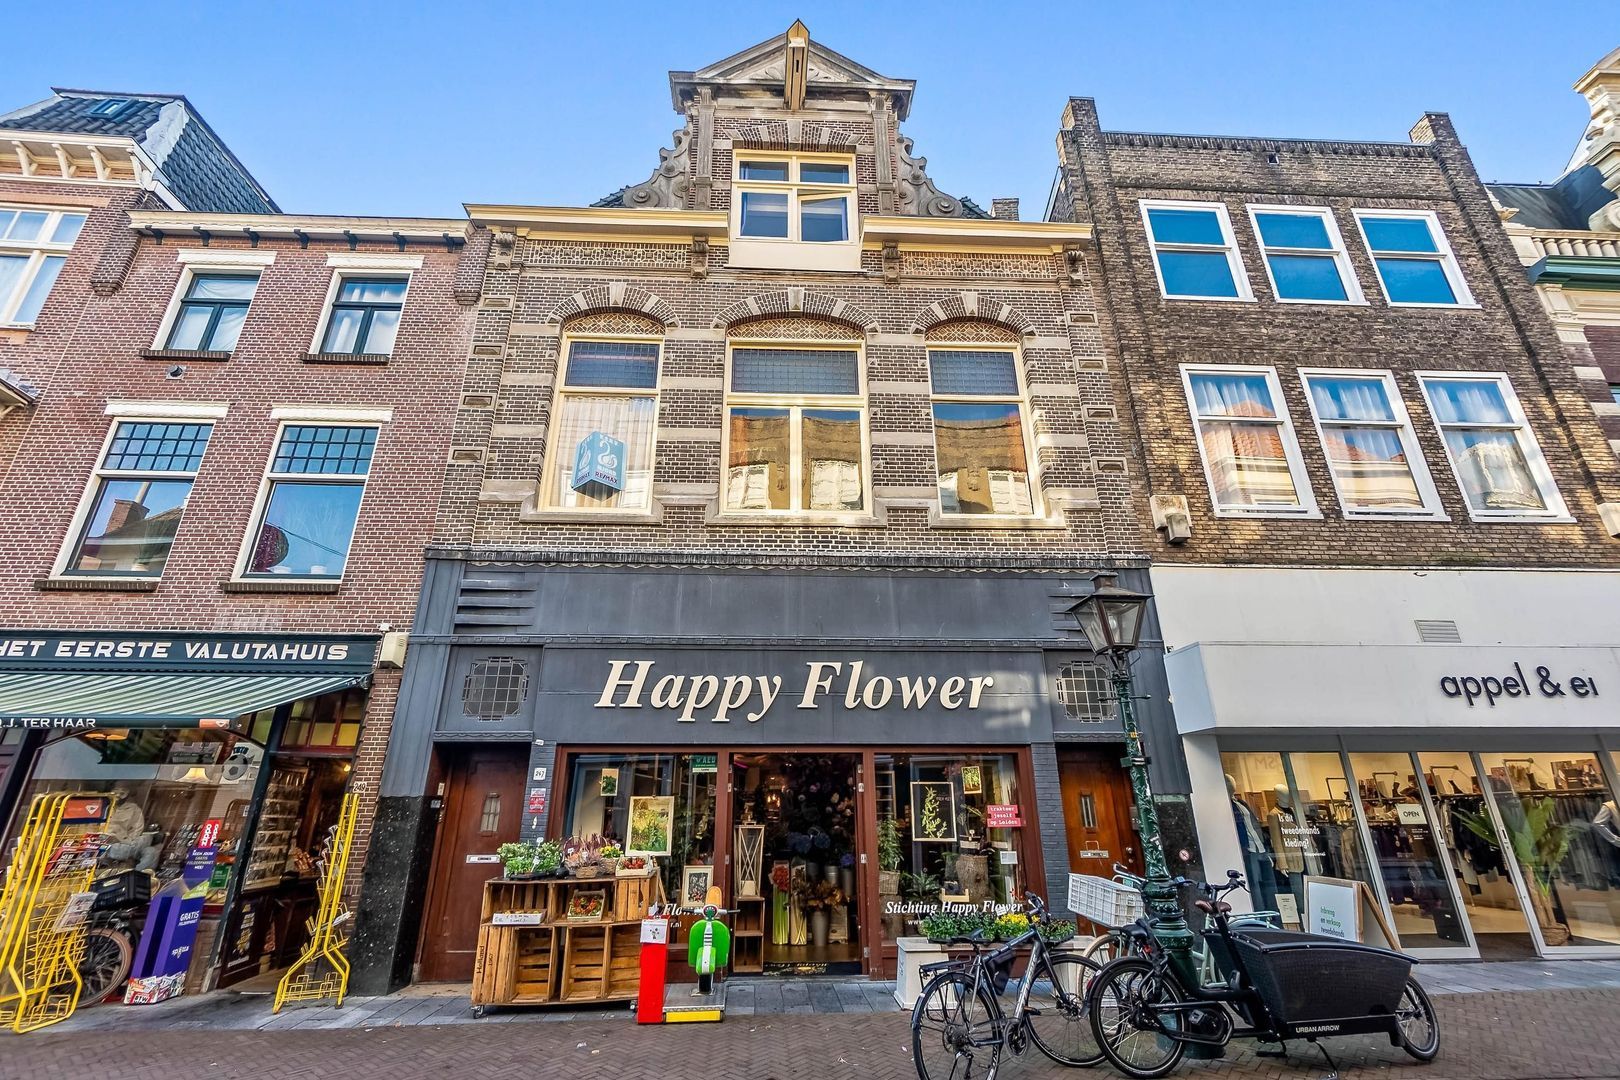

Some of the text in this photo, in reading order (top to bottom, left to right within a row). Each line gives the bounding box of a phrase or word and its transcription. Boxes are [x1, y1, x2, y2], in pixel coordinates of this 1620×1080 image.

[54, 641, 172, 658] EERSTE
[185, 642, 349, 660] VALUTAHUIS
[1440, 661, 1531, 706] appel
[1536, 665, 1567, 697] &
[594, 660, 994, 722] Happy Flower
[21, 718, 50, 728] TER
[54, 718, 96, 728] HAAR
[1281, 825, 1320, 835] tweedehands
[1284, 838, 1309, 849] kleding?
[885, 901, 937, 916] Stichting
[942, 900, 979, 916] Happy
[180, 911, 199, 922] GRATIS
[1327, 918, 1341, 928] verkoop
[1321, 927, 1345, 938] tweedehands
[476, 945, 484, 974] Holland
